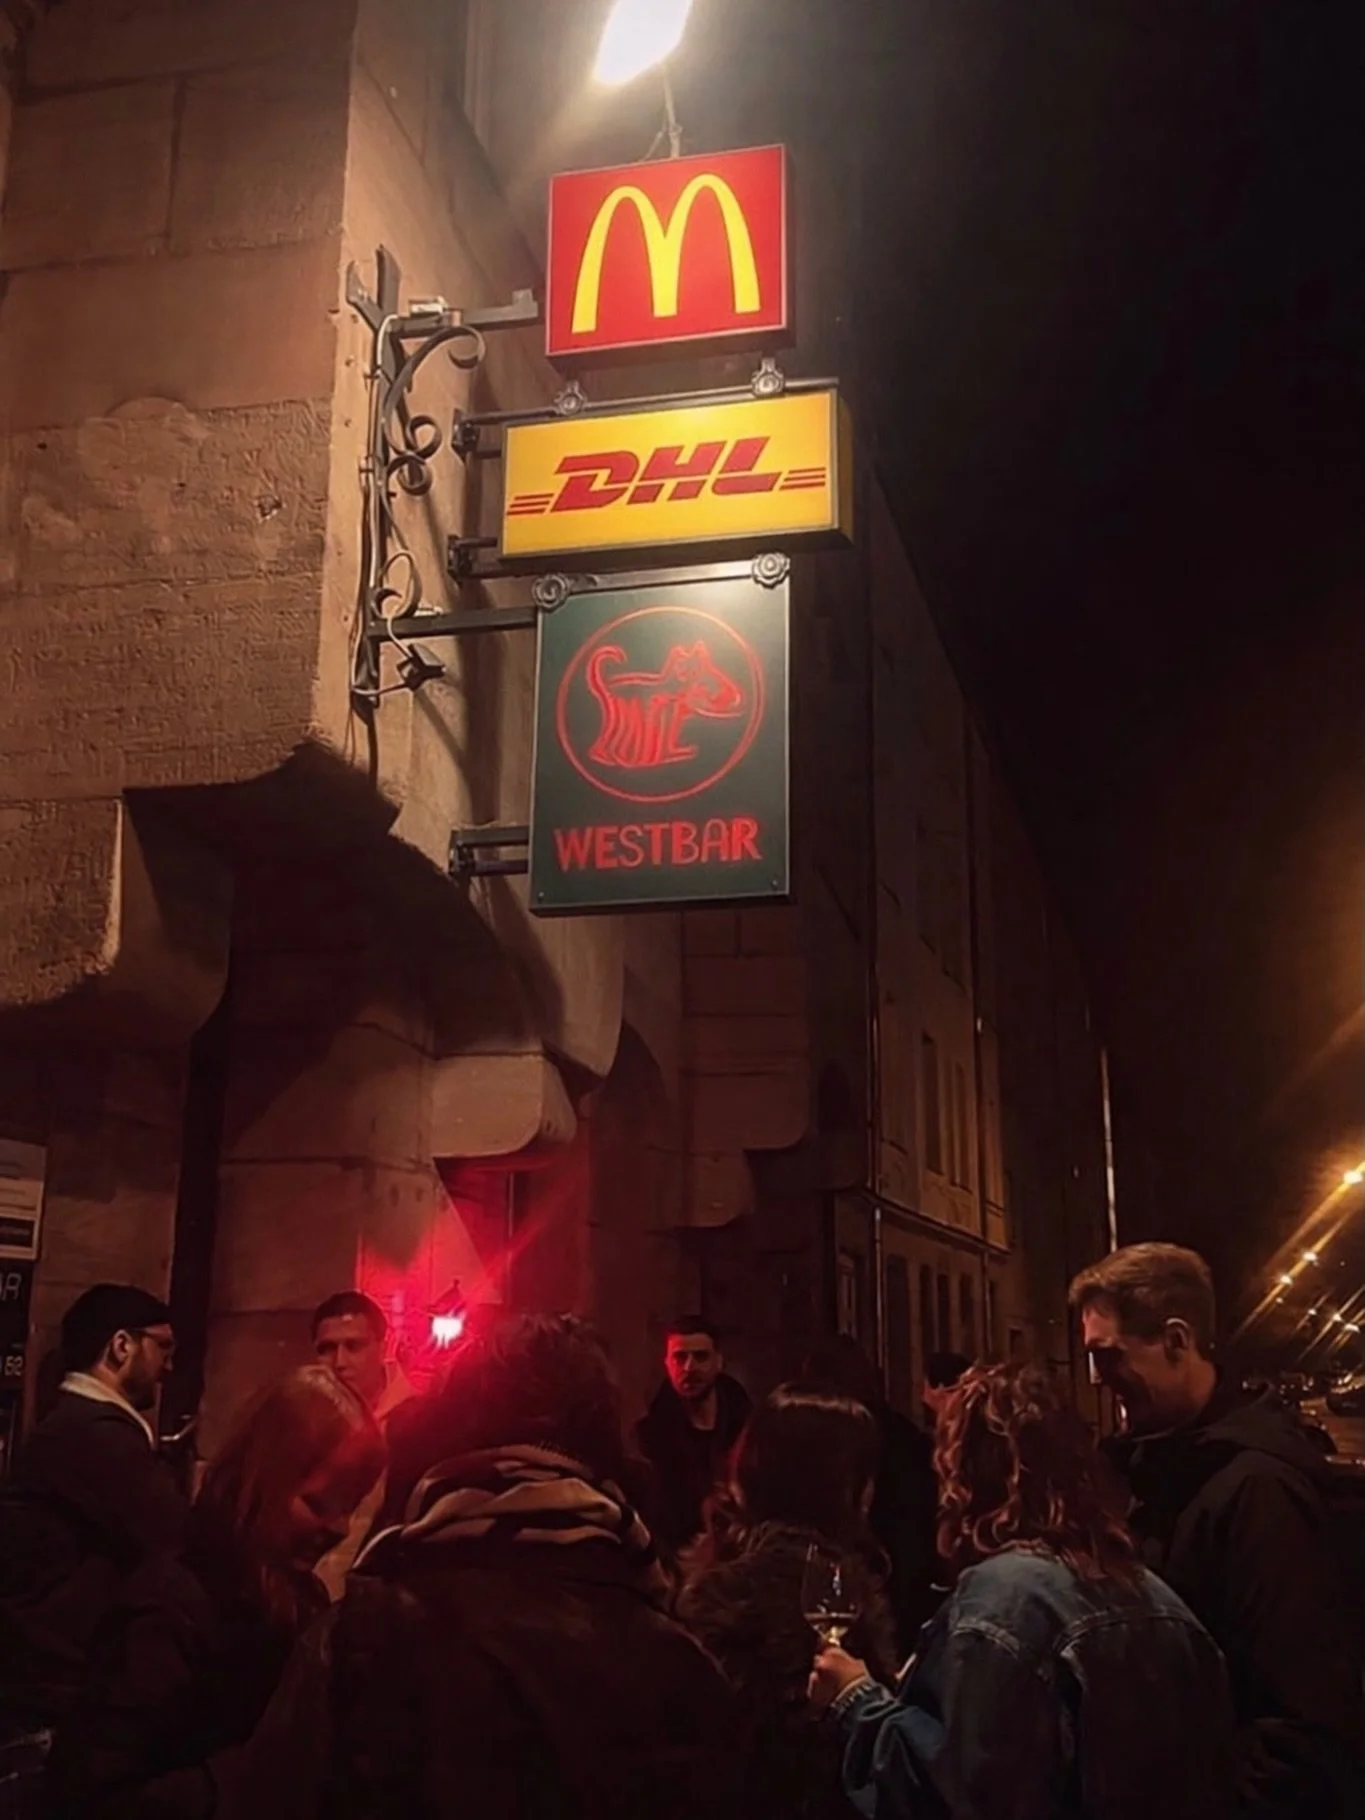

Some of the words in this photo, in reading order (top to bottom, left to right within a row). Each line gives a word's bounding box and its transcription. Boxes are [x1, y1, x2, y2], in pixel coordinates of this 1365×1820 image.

[571, 172, 761, 335] M
[550, 435, 783, 513] DHL
[553, 816, 763, 873] WESTBAR
